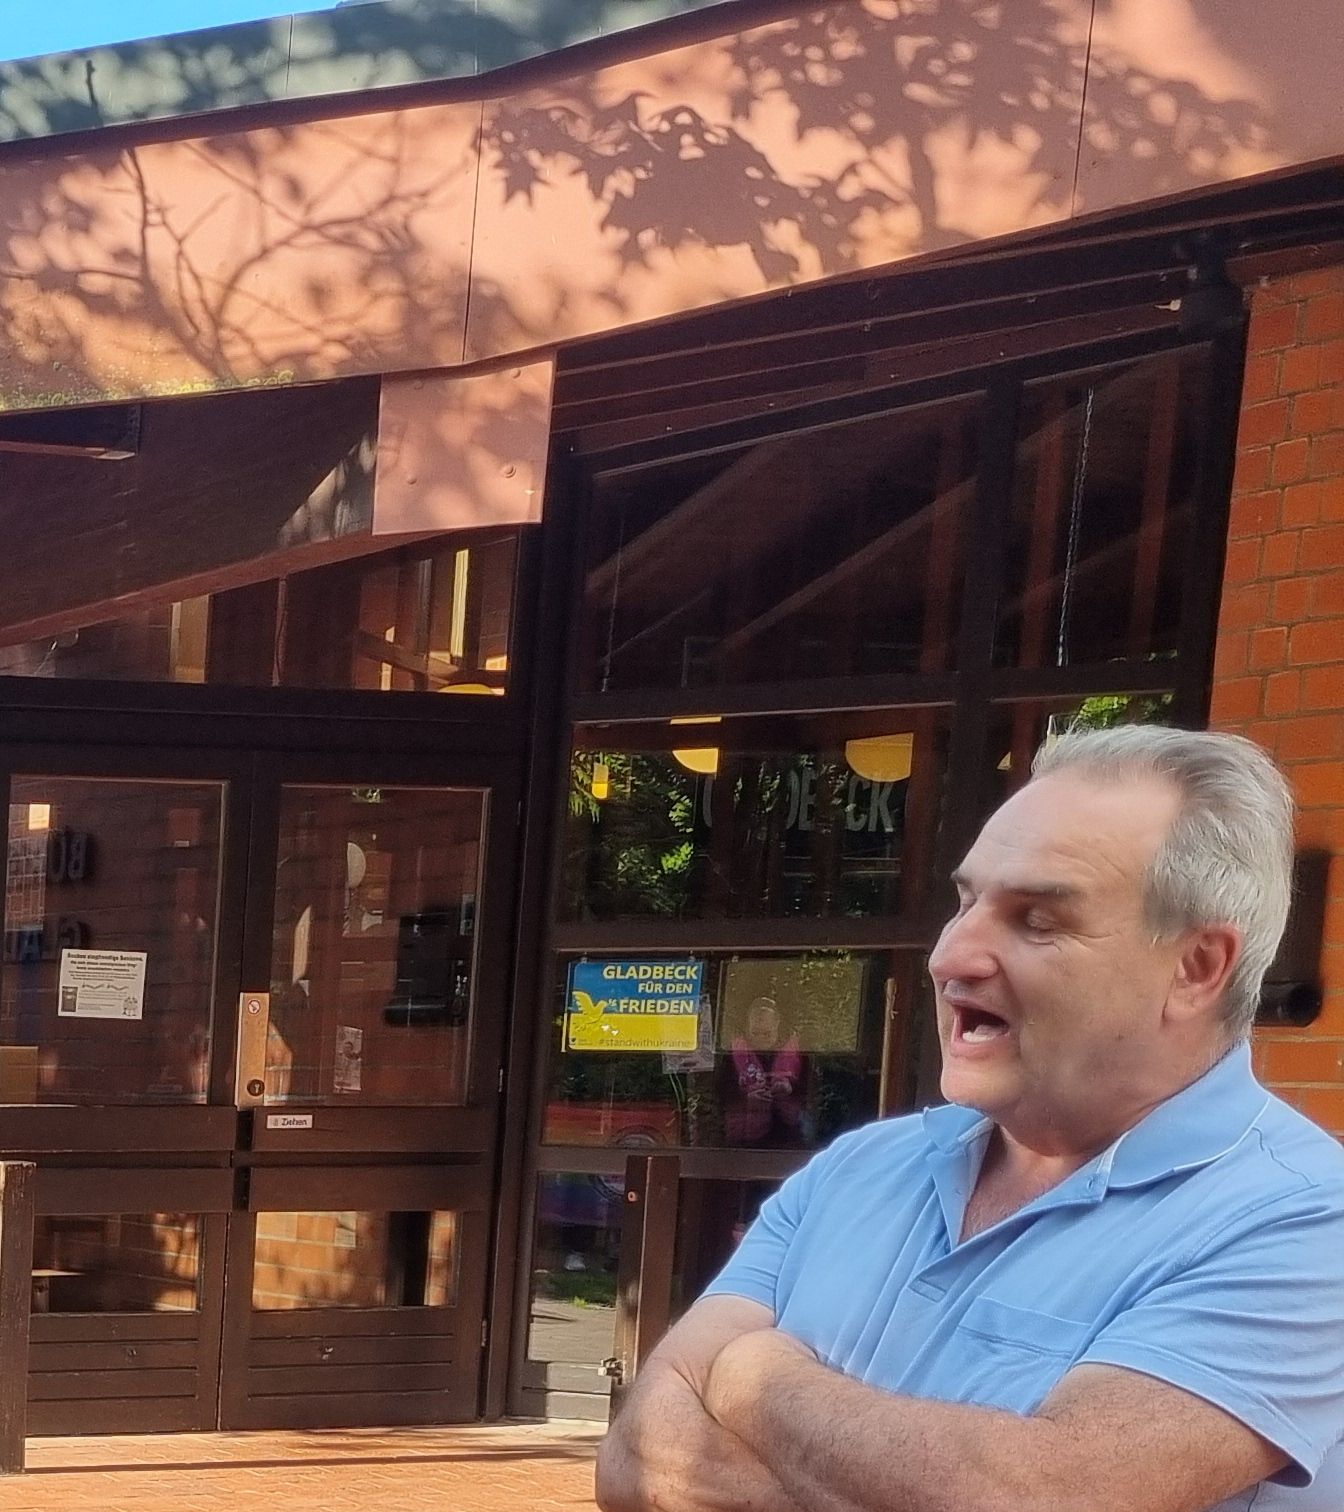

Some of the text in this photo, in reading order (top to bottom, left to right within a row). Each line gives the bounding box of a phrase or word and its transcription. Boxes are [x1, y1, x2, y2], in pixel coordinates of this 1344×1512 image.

[603, 965, 699, 980] GLADBECK
[638, 981, 693, 994] FÜR DEN
[619, 999, 694, 1013] FRIEDEN
